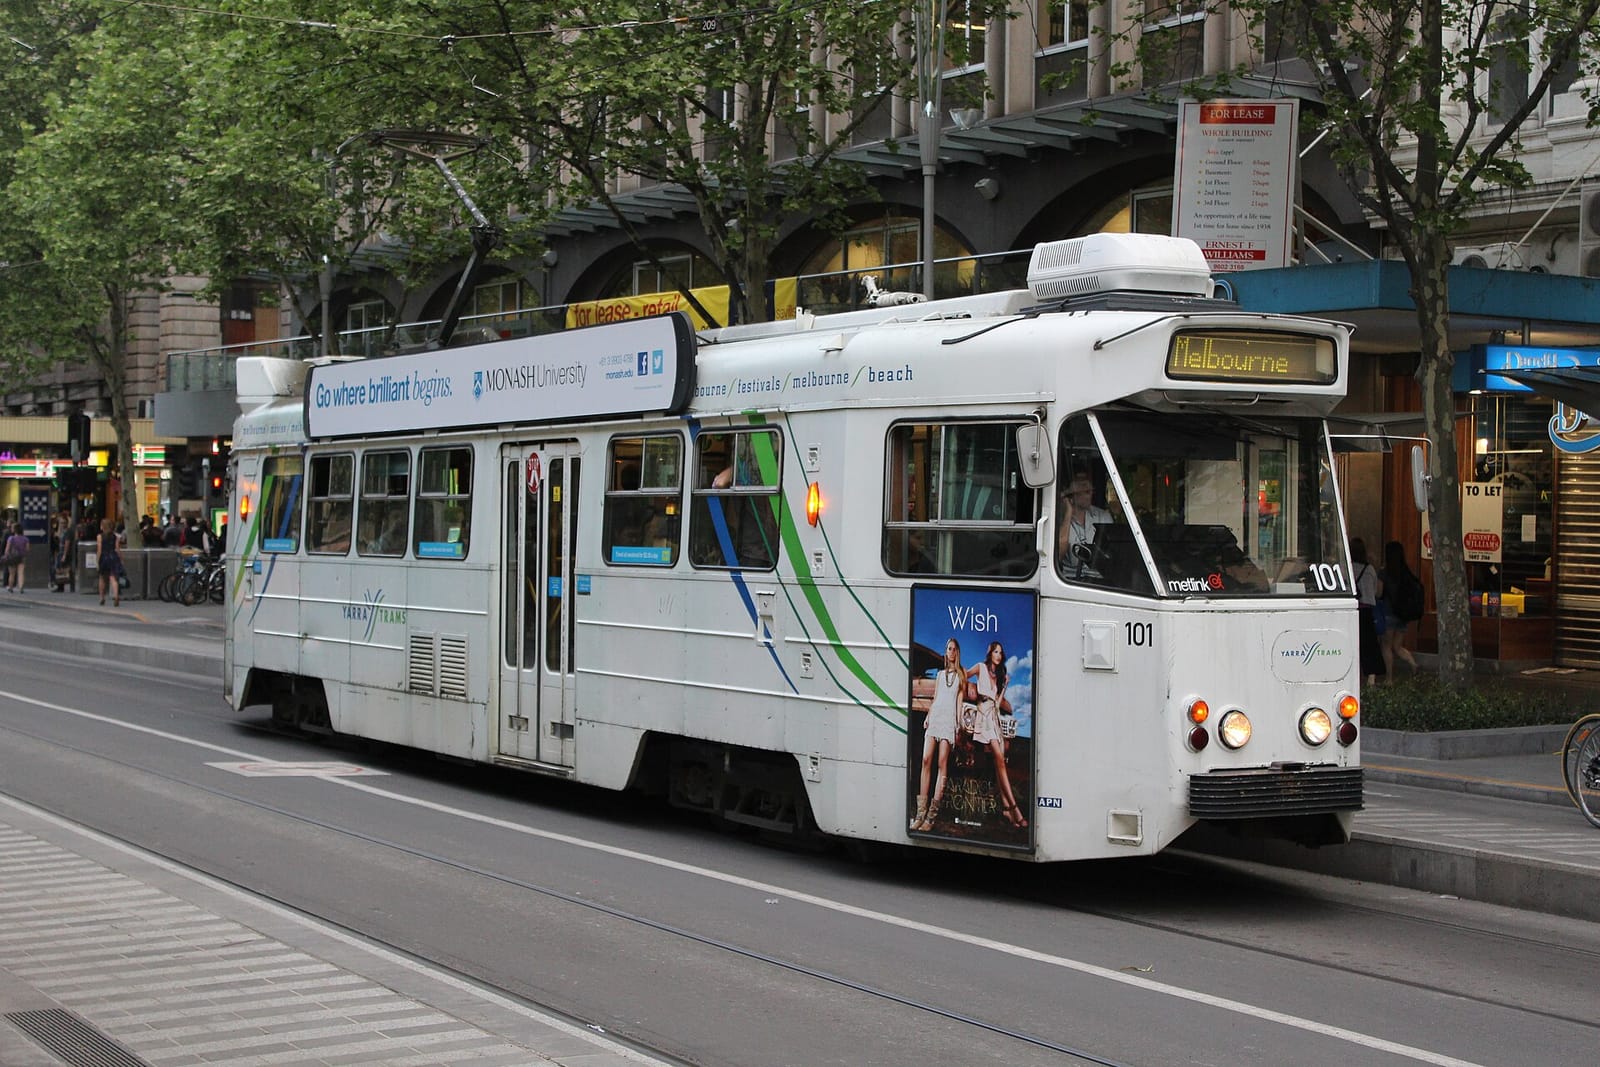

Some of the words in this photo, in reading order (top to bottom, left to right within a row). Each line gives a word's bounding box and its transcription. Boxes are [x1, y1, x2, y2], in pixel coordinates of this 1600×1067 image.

[702, 20, 716, 31] 209
[1210, 109, 1231, 119] FOR
[1233, 109, 1264, 119] LEASE
[1202, 129, 1231, 137] WHOLE
[1232, 129, 1272, 138] BUILDING
[1206, 241, 1243, 249] ERNEST
[1204, 250, 1254, 260] WILLIAMS
[574, 304, 592, 328] for
[595, 302, 632, 325] lease
[642, 295, 681, 318] retail
[1174, 336, 1288, 373] Melbourne
[485, 365, 536, 392] MONASH
[536, 361, 588, 389] University
[737, 375, 781, 394] festivals
[792, 371, 849, 390] melbourne
[868, 364, 913, 382] beach
[316, 383, 330, 409] Go
[333, 381, 366, 407] where
[368, 375, 410, 404] brilliant
[412, 369, 453, 406] begins.
[1466, 485, 1480, 496] TO
[1484, 486, 1501, 497] LET
[24, 512, 47, 520] Police
[1168, 576, 1211, 592] metlink
[1309, 563, 1346, 591] 101
[342, 605, 368, 621] YARRA
[379, 609, 406, 624] TRAMS
[948, 605, 998, 632] Wish
[1125, 621, 1153, 648] 101
[1039, 799, 1060, 808] APN
